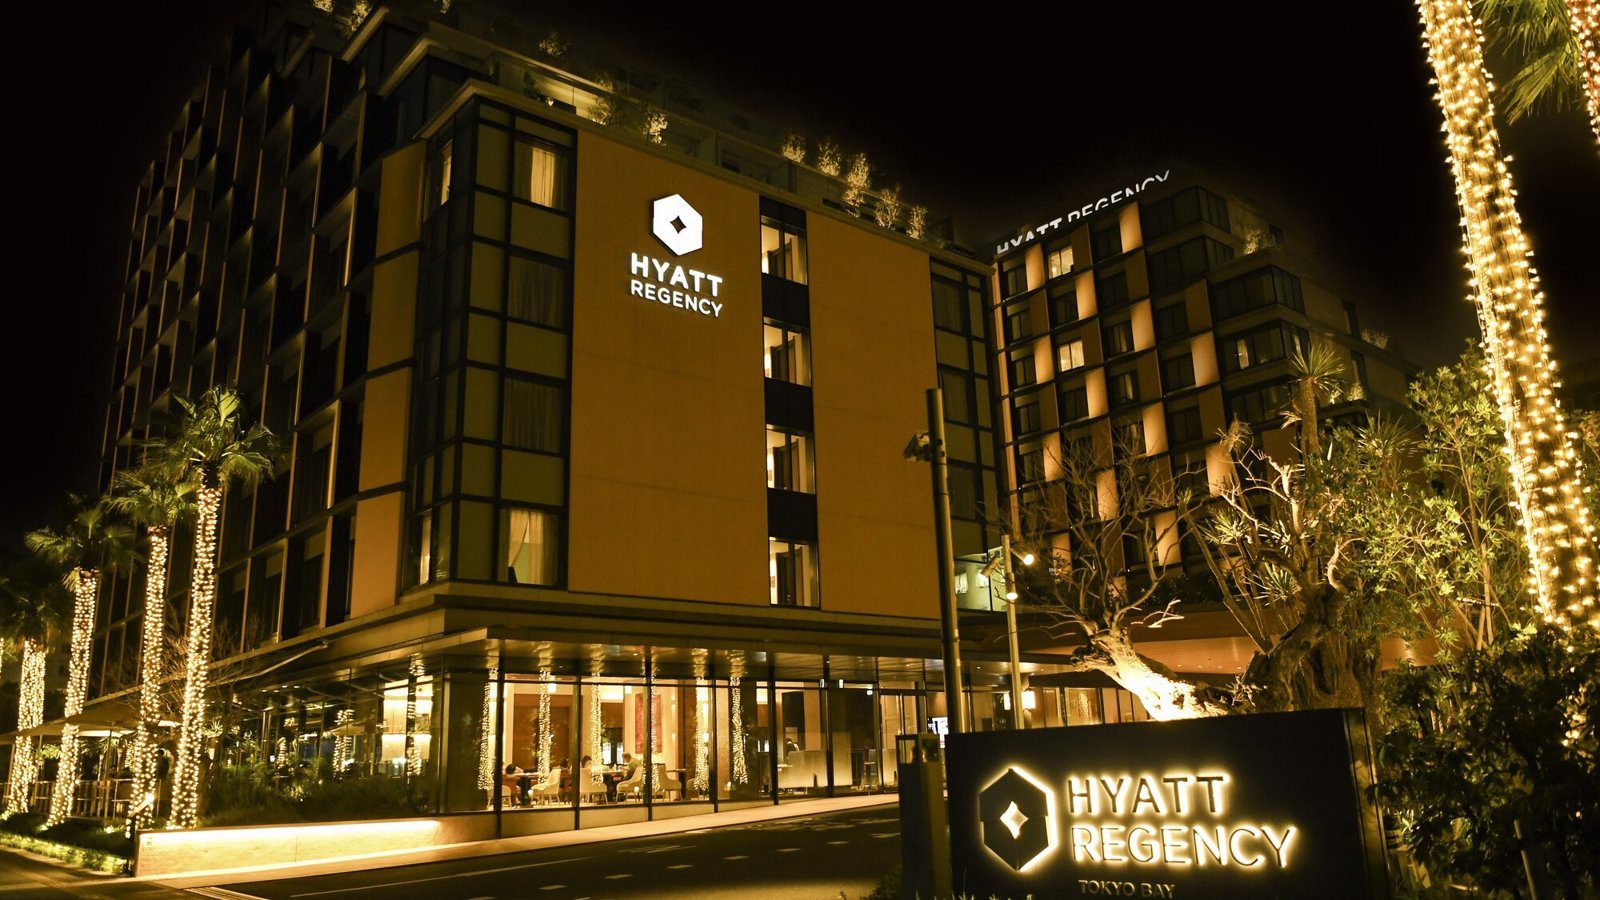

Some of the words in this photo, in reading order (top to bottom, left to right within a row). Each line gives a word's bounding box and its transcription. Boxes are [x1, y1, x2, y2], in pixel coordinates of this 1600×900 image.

[631, 252, 723, 297] HYATT
[631, 279, 722, 317] REGENCY
[1067, 773, 1227, 815] HYATT
[1070, 824, 1296, 868] REGENCY
[1078, 880, 1136, 896] TOKYO
[1140, 883, 1175, 899] BAY
